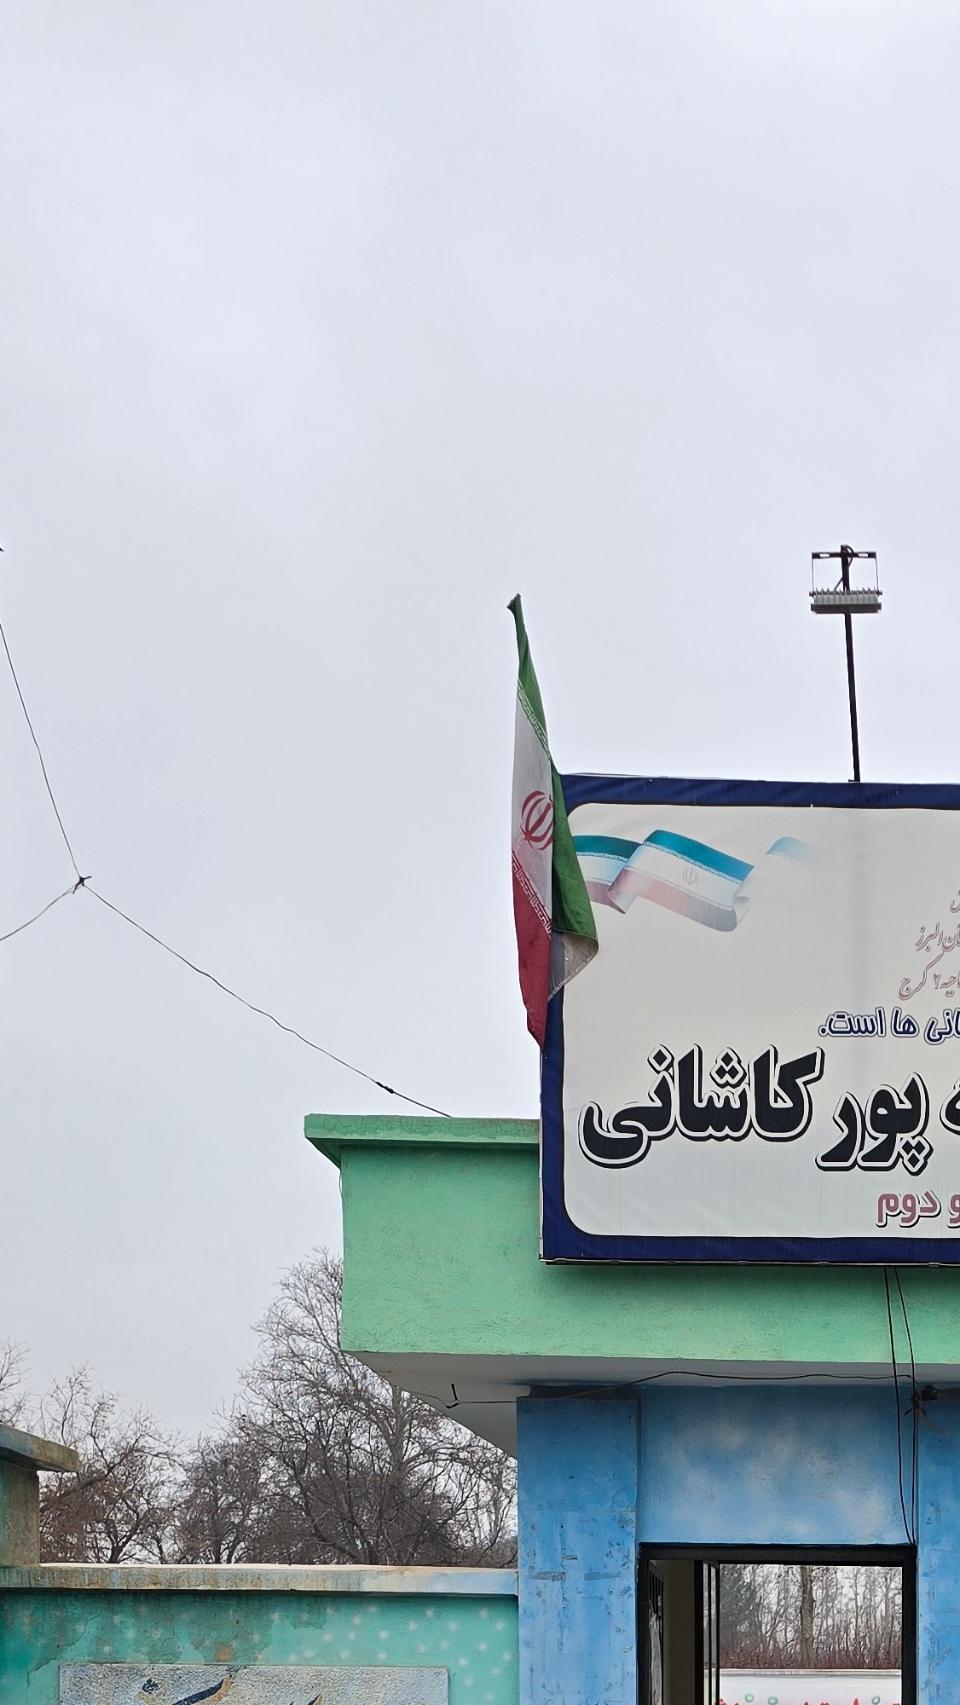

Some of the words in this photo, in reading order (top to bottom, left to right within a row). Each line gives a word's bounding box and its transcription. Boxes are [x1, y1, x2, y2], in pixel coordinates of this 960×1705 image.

[915, 922, 945, 951] البرز
[898, 950, 944, 1001] کرج
[818, 1007, 885, 1037] است.
[891, 1007, 919, 1037] ها
[578, 1043, 824, 1169] کاشانی
[816, 1072, 933, 1175] پور
[874, 1190, 942, 1227] دوم
